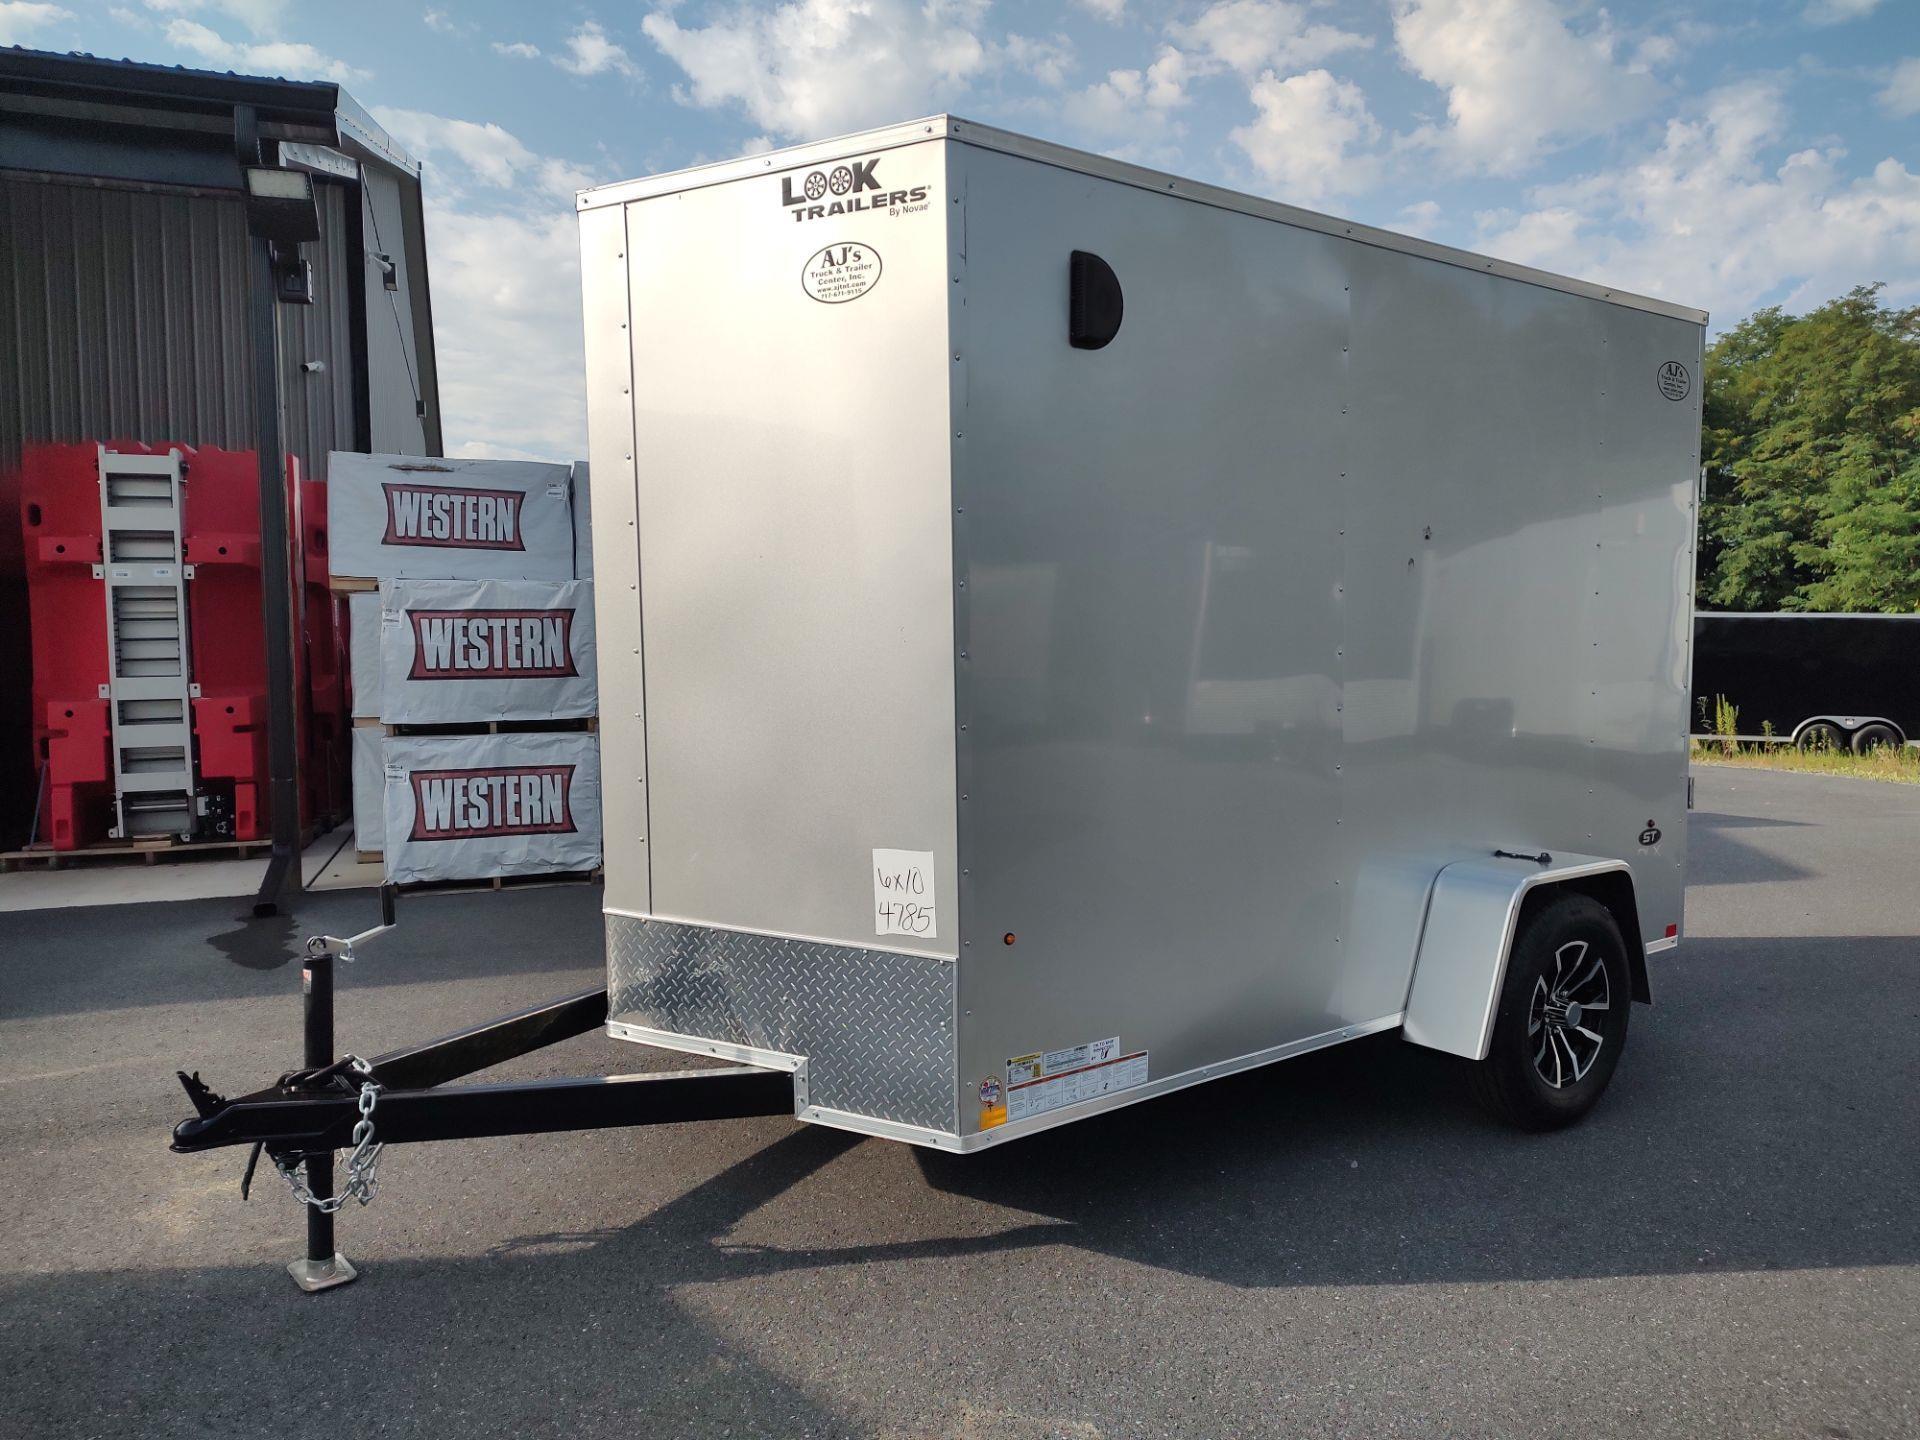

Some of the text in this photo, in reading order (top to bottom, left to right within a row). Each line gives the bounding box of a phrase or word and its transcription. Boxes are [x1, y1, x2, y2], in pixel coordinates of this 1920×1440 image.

[782, 158, 882, 206] LOOK
[791, 185, 928, 222] TRAILERS
[889, 206, 901, 217] By
[810, 270, 833, 278] Truck
[845, 263, 873, 272] Trailer
[821, 246, 862, 268] AJ's
[1665, 363, 1684, 378] AJ's
[392, 490, 515, 543] WESTERN
[420, 616, 566, 672] WESTERN
[420, 773, 564, 831] WESTERN
[878, 901, 934, 932] 4785
